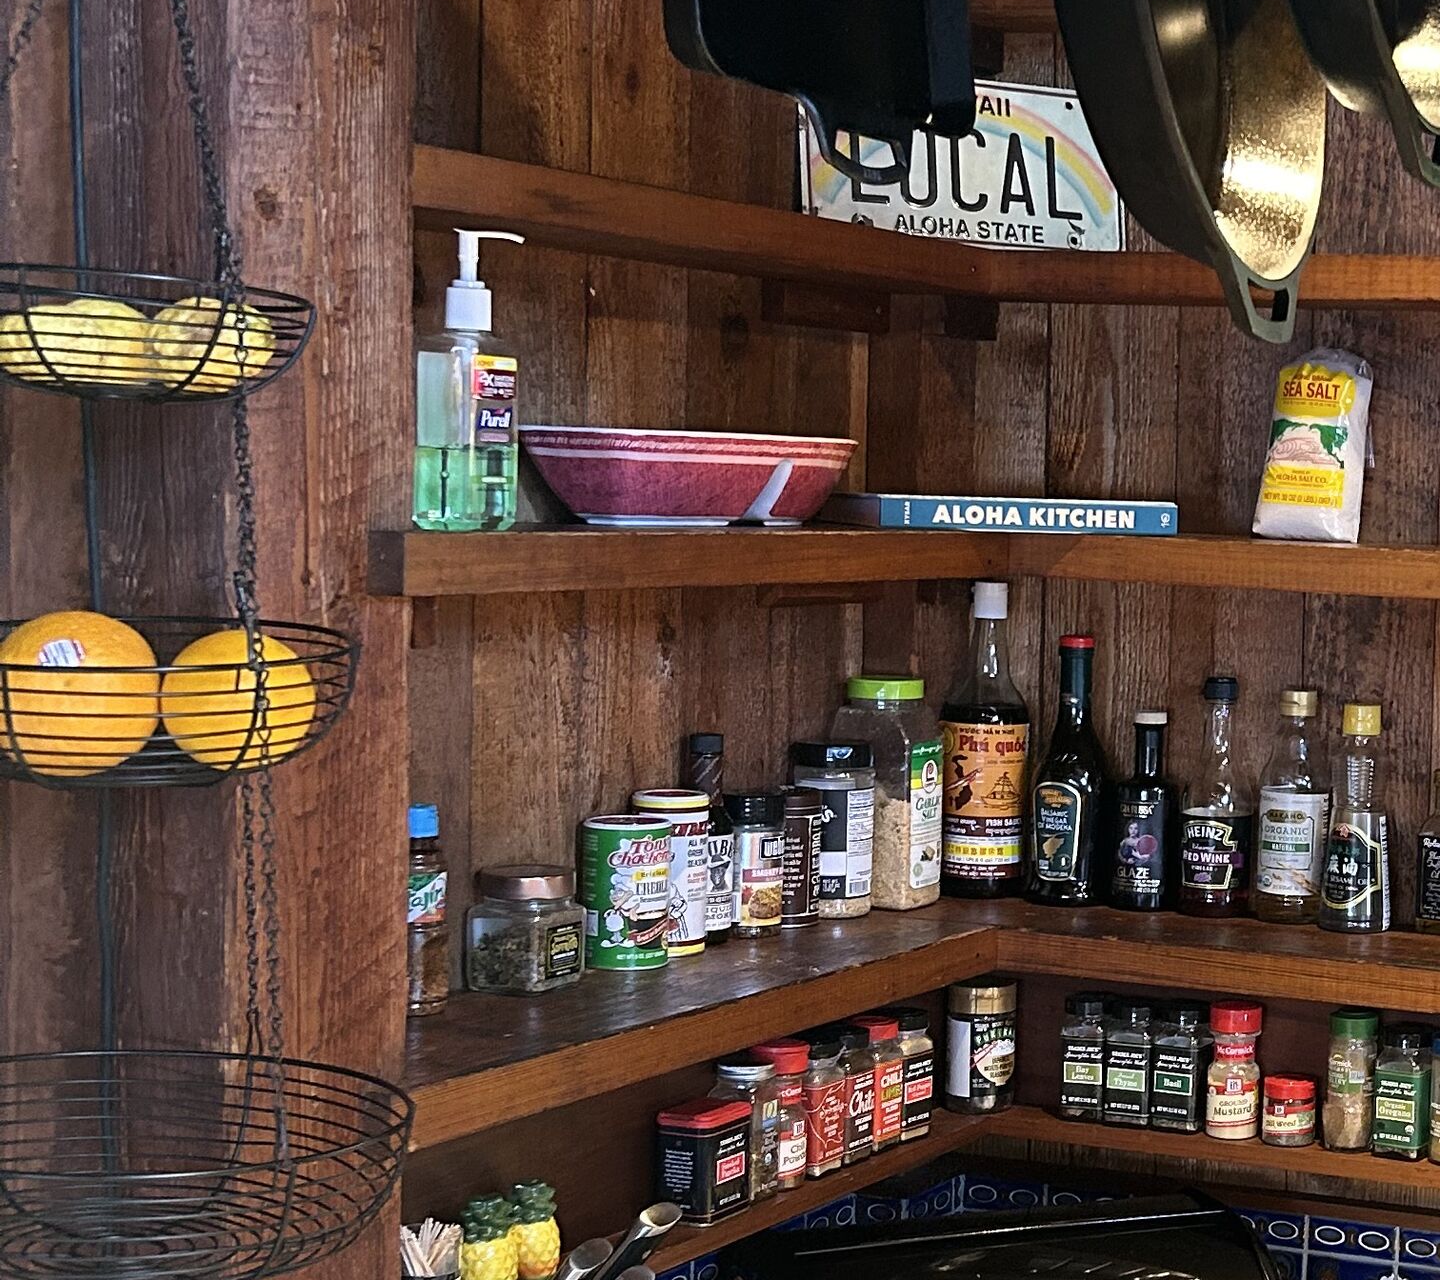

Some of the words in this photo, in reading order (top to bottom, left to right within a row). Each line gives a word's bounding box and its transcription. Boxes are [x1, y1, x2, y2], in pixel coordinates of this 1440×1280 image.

[850, 129, 1083, 220] LOCAL
[894, 214, 971, 239] ALOHA
[977, 221, 1045, 244] STATE
[1283, 381, 1303, 398] SEA
[1306, 383, 1341, 401] SALT
[932, 504, 1023, 526] ALOHA
[1029, 507, 1135, 529] KITCHEN
[958, 734, 989, 753] Phú
[1187, 825, 1226, 841] HEINZ
[1264, 824, 1309, 836] ORGANIC
[764, 840, 785, 857] web
[1271, 843, 1296, 852] NATURAL
[1183, 849, 1200, 861] RED
[1200, 853, 1230, 864] WINE
[1117, 866, 1150, 880] GLAZE
[975, 1027, 1015, 1044] FURIKA
[1216, 1045, 1255, 1055] McCormick
[1113, 1077, 1138, 1088] Thyme
[1163, 1078, 1182, 1089] Basil
[1213, 1104, 1252, 1117] Mustard
[1378, 1106, 1411, 1118] Oregano
